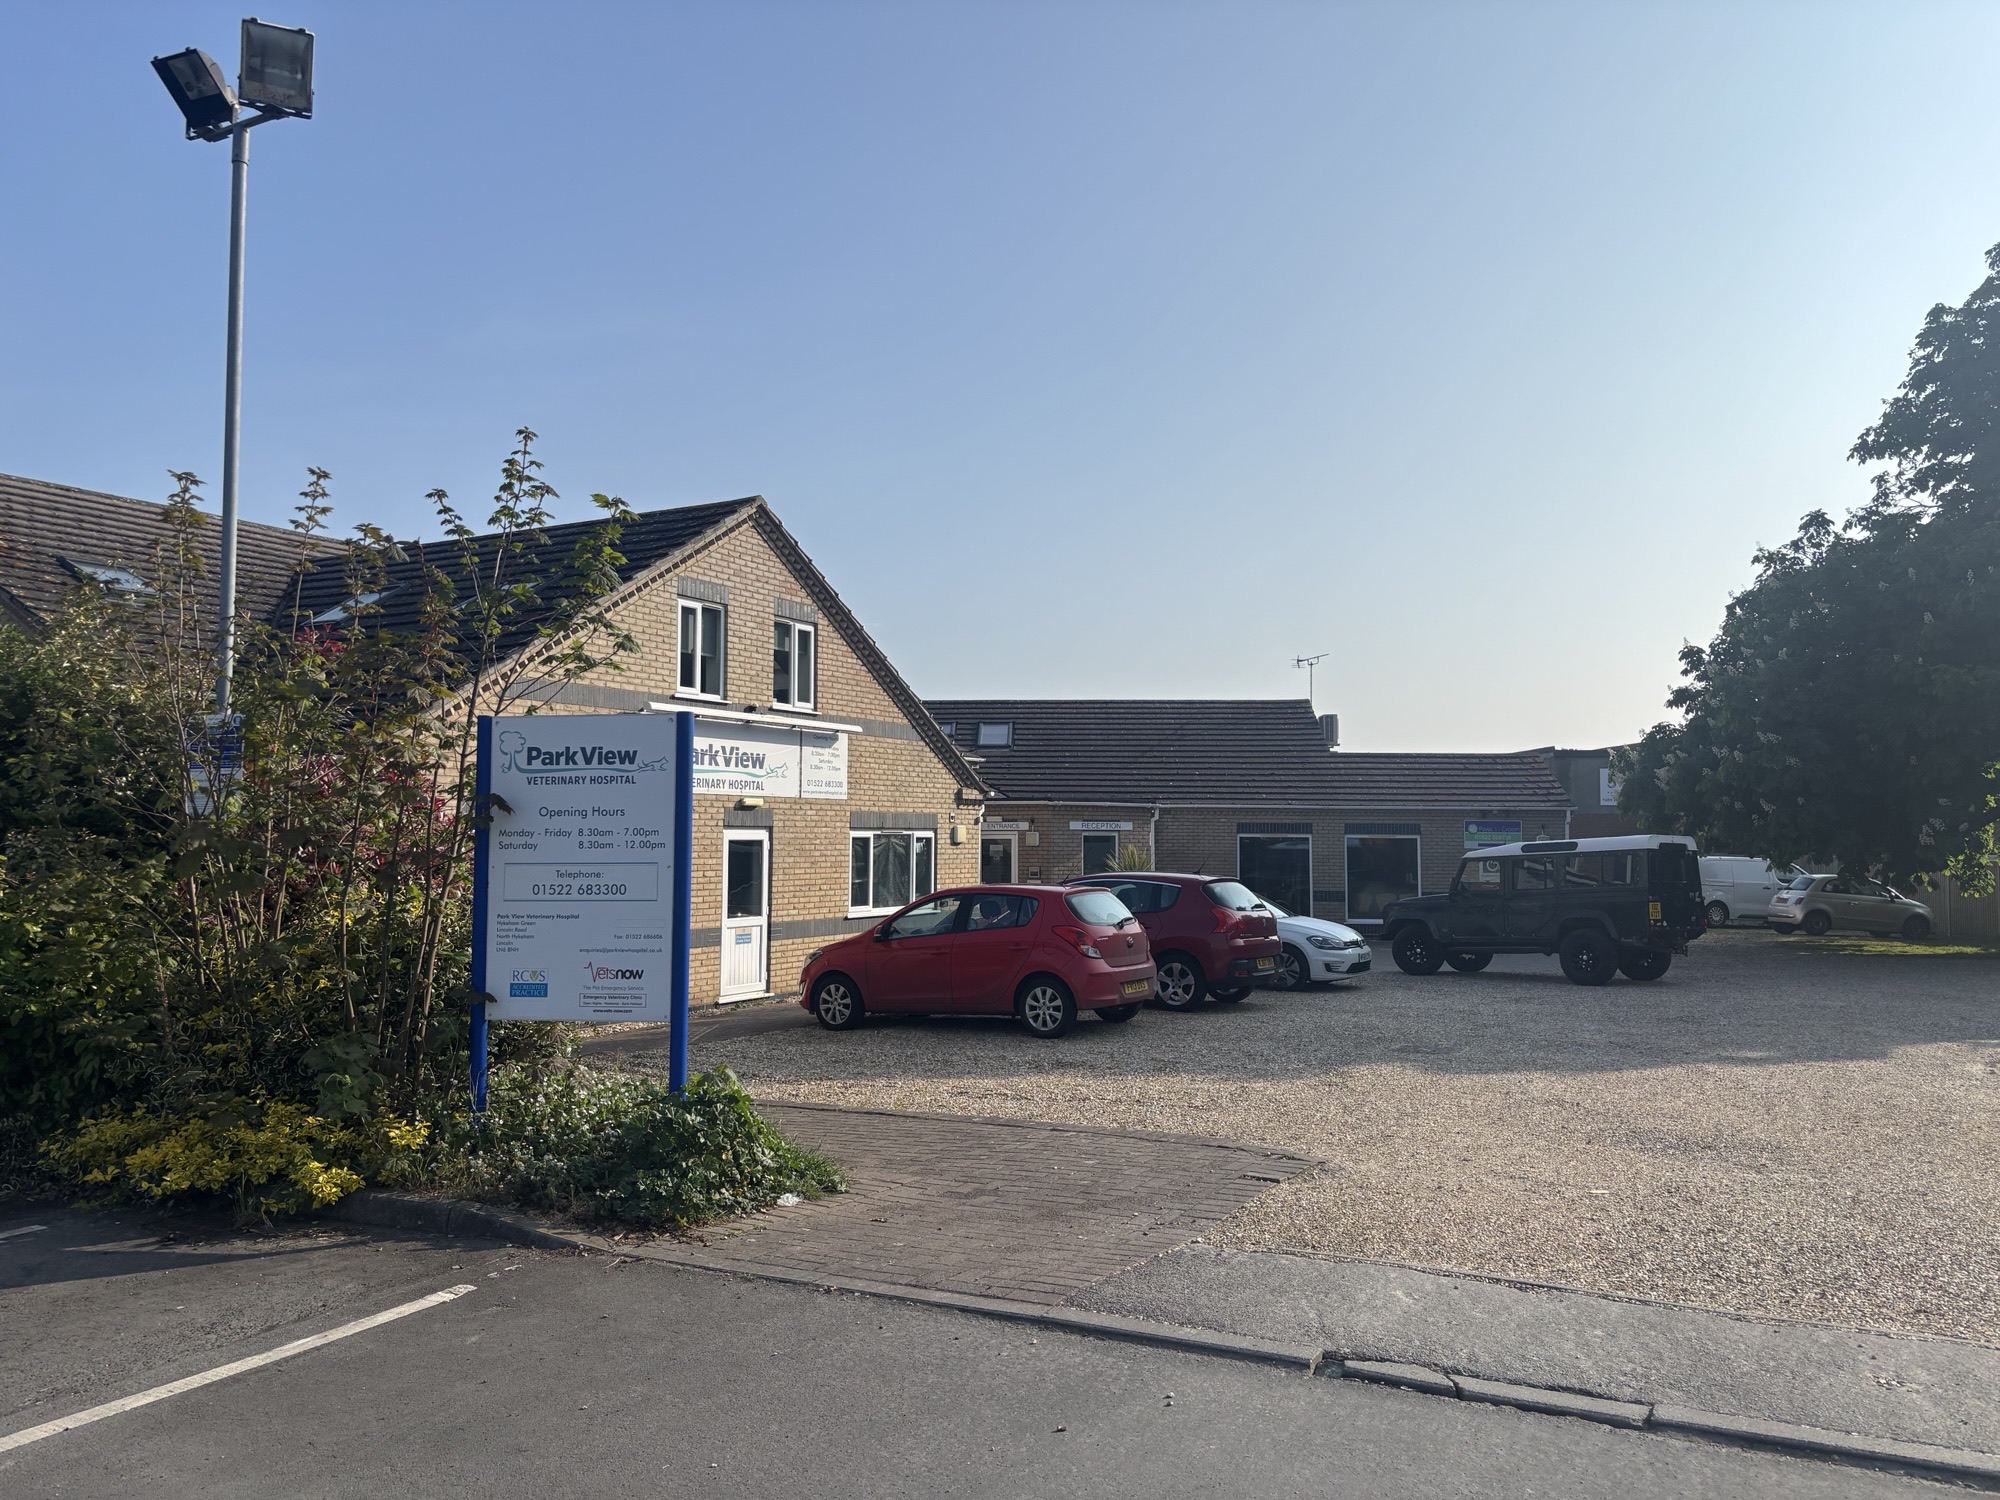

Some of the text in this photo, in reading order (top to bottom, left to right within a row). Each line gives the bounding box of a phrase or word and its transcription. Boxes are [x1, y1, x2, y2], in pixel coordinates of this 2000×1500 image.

[526, 746, 638, 766] Park View
[692, 744, 766, 769] ark View
[526, 775, 636, 785] VETERINARY HOSPITAL
[692, 778, 764, 791] ERINARY HOSPITAL
[538, 806, 625, 819] Opening Hours
[498, 828, 535, 838] Monday
[544, 828, 572, 838] Friday
[578, 828, 614, 837] 8.30am
[624, 828, 660, 838] 7.00pm
[498, 841, 538, 851] Saturday
[578, 841, 614, 849] 8.30am
[624, 840, 666, 851] 12.00pm
[556, 870, 604, 880] Telephone:
[532, 884, 627, 895] 01522 683300
[512, 970, 546, 982] RCVS
